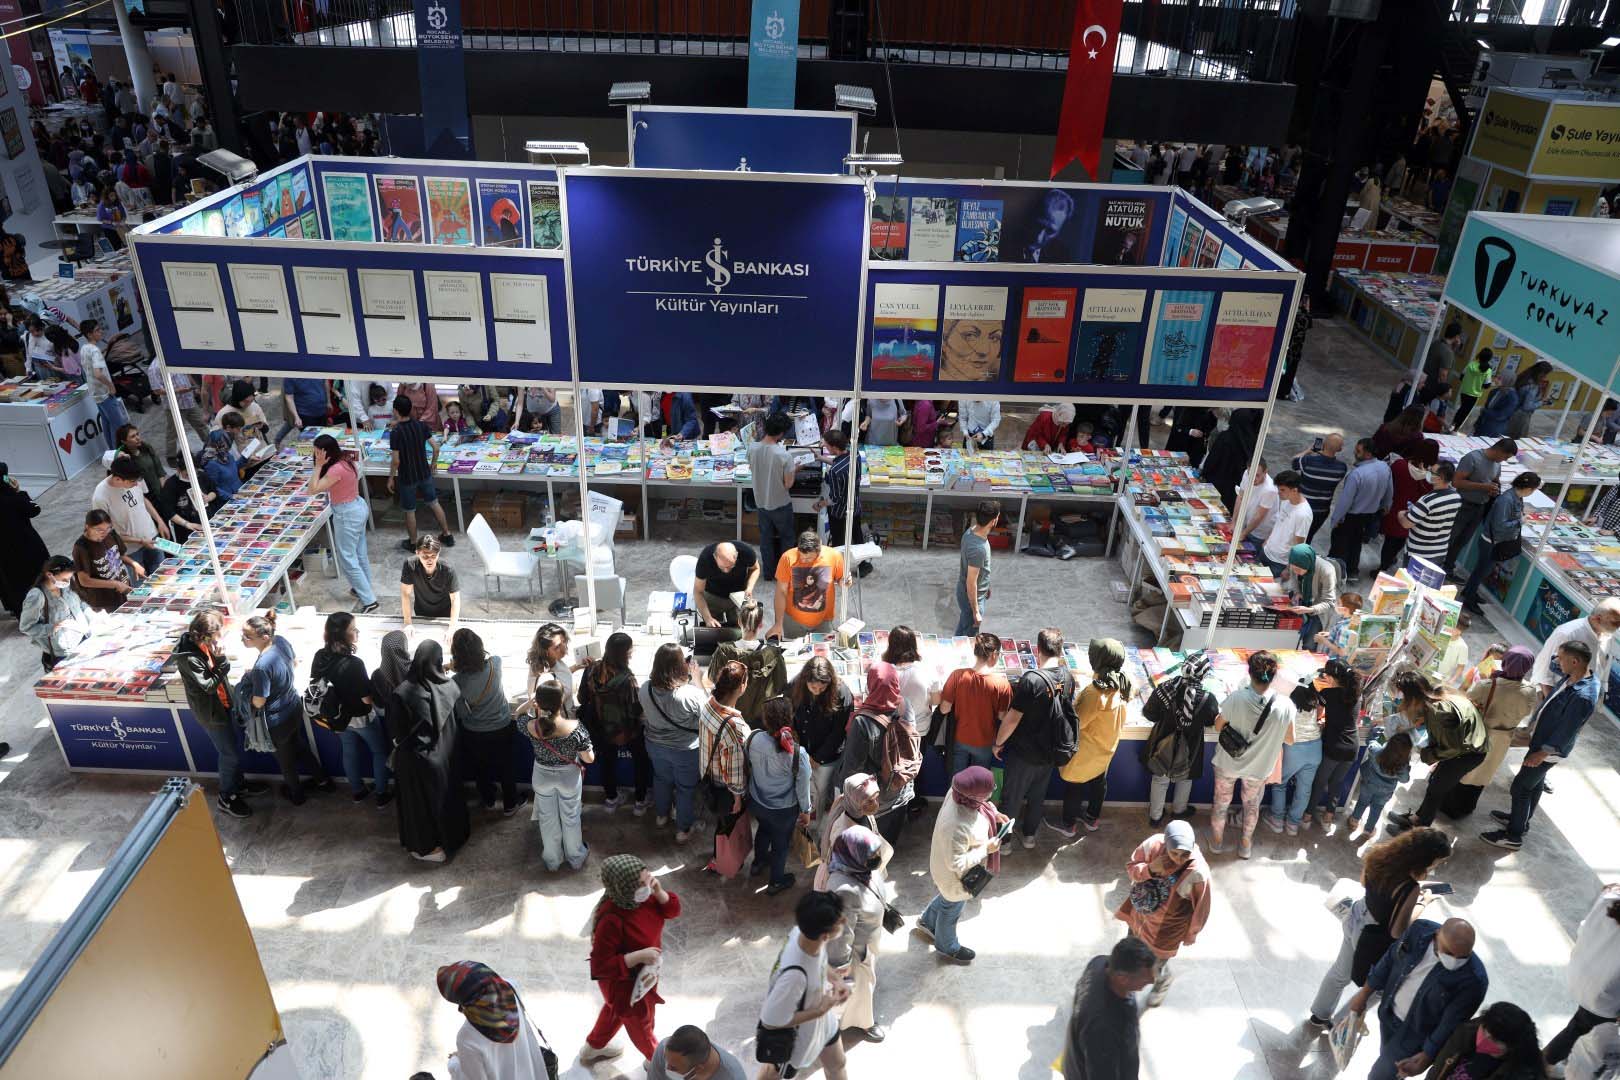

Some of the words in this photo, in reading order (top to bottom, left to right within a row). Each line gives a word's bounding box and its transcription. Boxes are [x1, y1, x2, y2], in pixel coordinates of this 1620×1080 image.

[1567, 128, 1593, 141] Şule
[1107, 204, 1146, 214] ATATÜRK
[1105, 217, 1145, 228] NUTUK
[625, 256, 703, 273] TÜRKİYE
[733, 261, 809, 277] BANKASI
[1520, 270, 1609, 326] TURKUVAZ
[655, 297, 706, 313] Kültür
[709, 299, 779, 316] Yayınları
[1526, 302, 1577, 340] ÇOCUK
[70, 723, 111, 733] TÜRKİYE
[126, 726, 166, 735] BANKASI
[92, 741, 119, 749] Kültür
[119, 742, 157, 751] Yayınları
